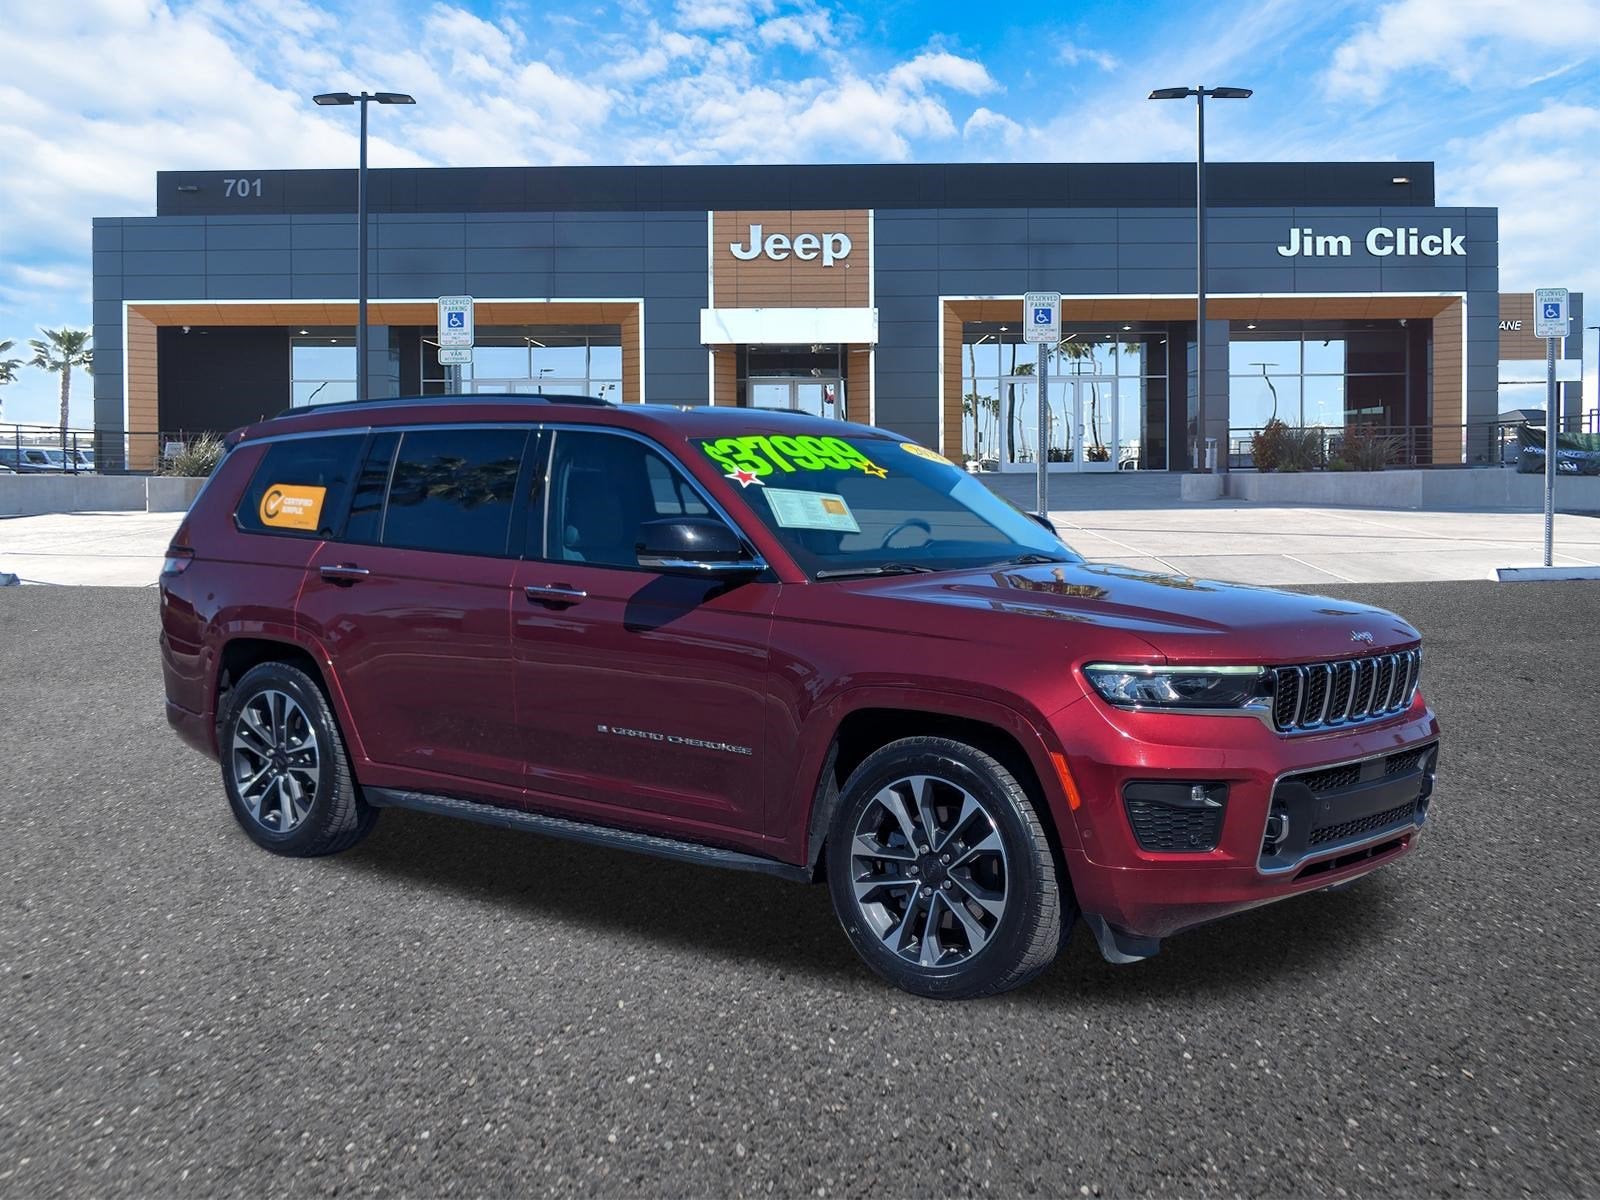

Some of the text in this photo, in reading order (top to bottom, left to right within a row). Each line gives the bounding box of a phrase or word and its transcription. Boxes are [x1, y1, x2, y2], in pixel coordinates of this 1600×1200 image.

[223, 178, 262, 198] 701
[730, 223, 852, 267] Jeep
[1277, 227, 1467, 257] Jim Click
[702, 435, 870, 477] $37999
[1350, 630, 1373, 645] Jeep
[611, 726, 752, 756] GRAND CHEROKEE
